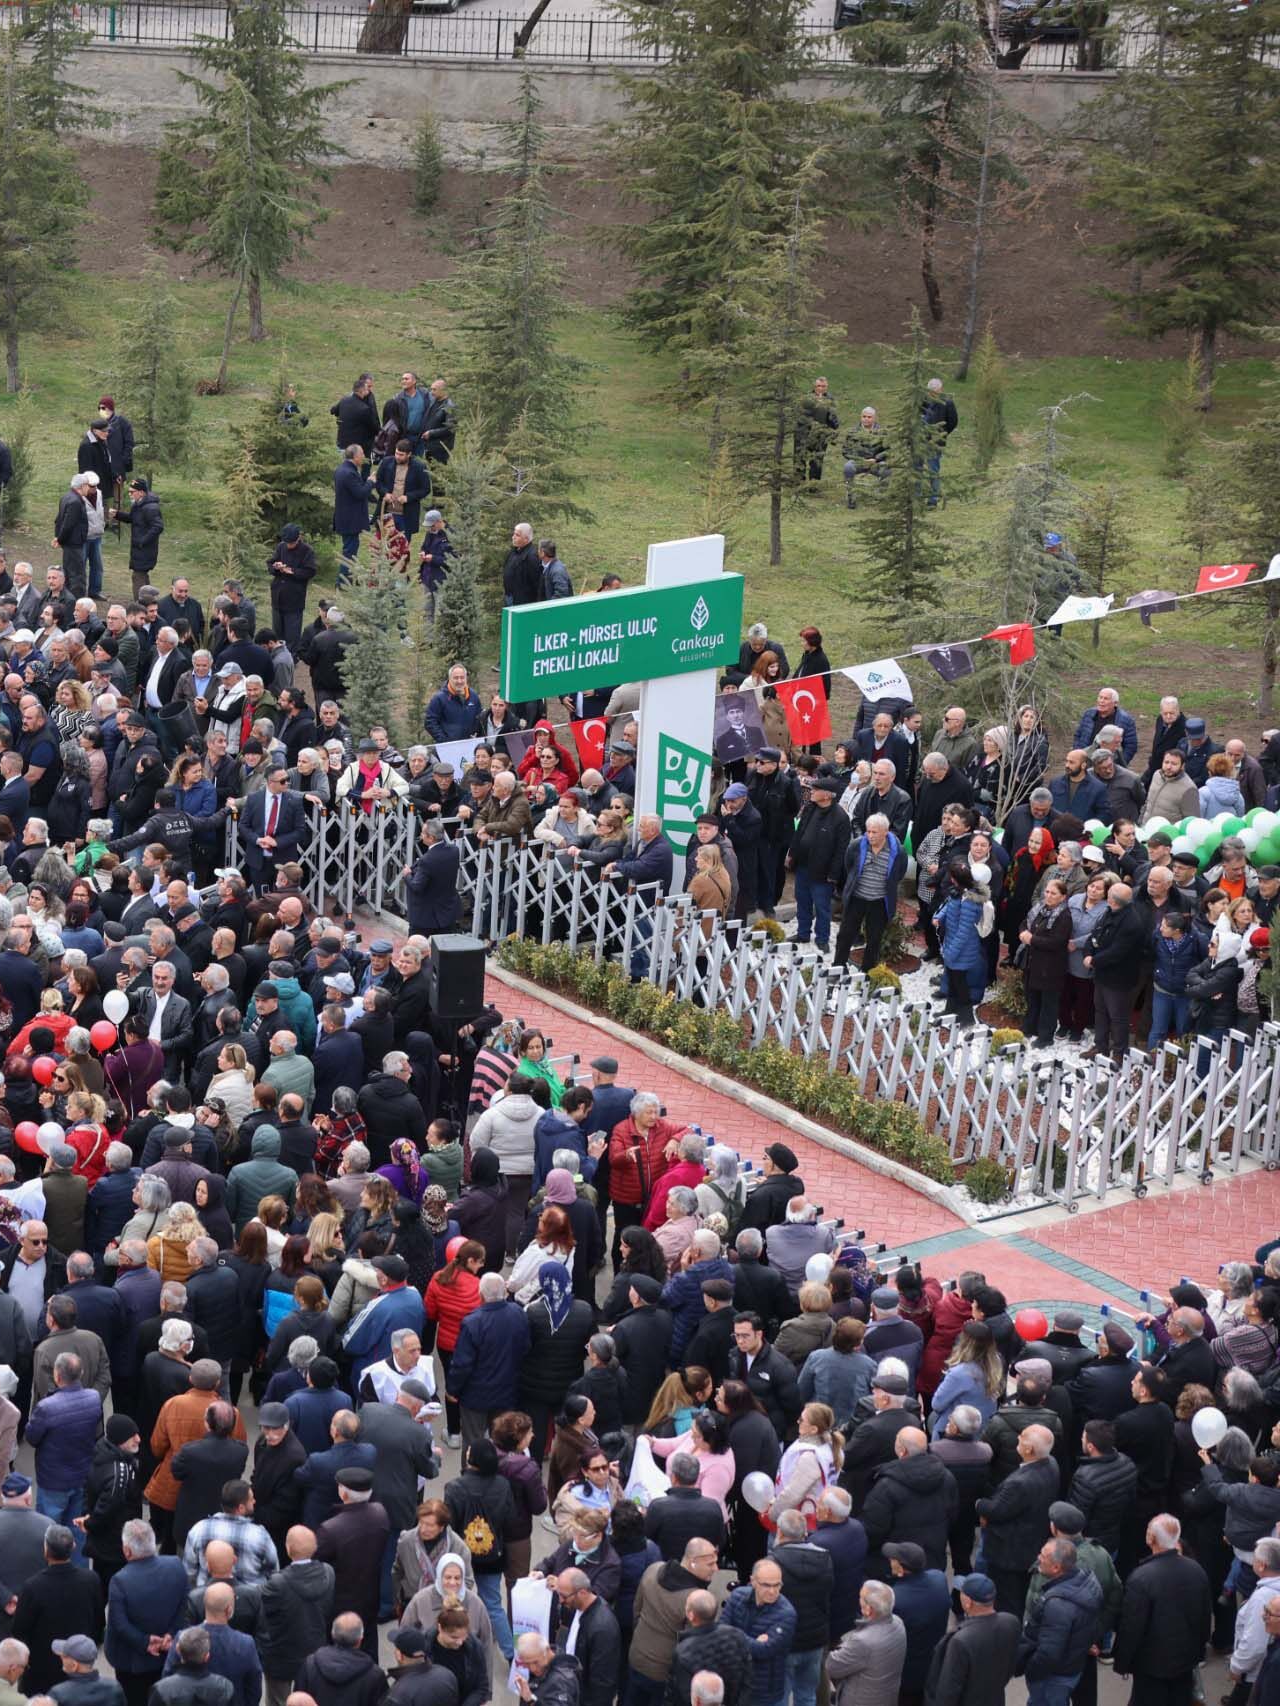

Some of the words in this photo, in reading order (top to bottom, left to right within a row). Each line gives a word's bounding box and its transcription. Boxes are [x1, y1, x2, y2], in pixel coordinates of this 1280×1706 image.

[533, 633, 568, 653] İLKER
[579, 624, 625, 645] MÜRSEL
[627, 616, 658, 637] ULUÇ
[671, 632, 724, 654] Çankaya
[532, 651, 575, 677] EMEKLİ
[578, 643, 620, 668] LOKALİ
